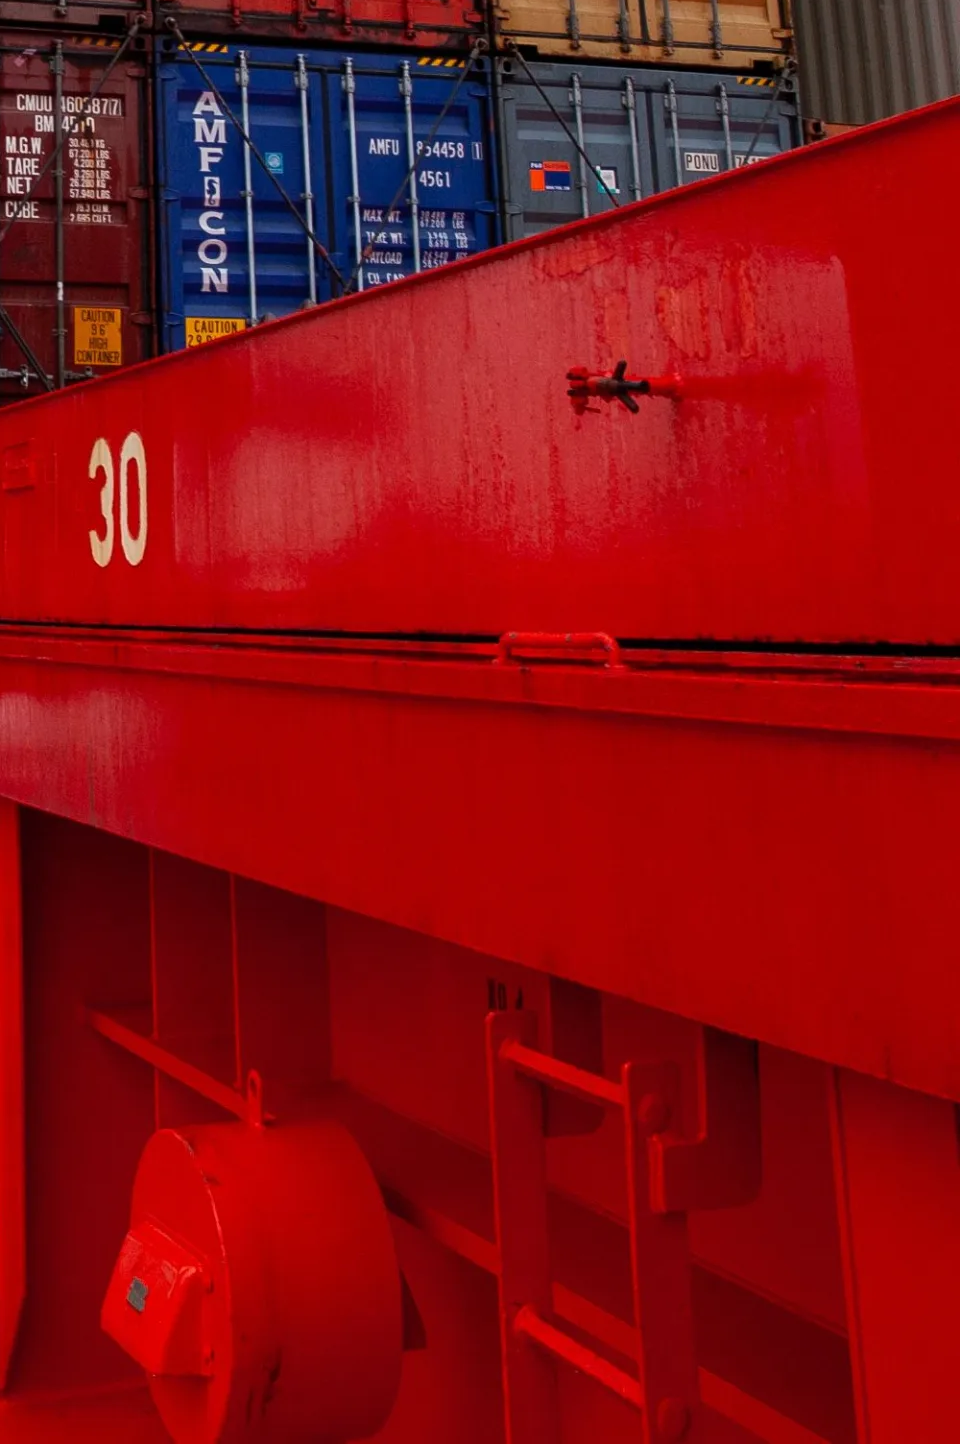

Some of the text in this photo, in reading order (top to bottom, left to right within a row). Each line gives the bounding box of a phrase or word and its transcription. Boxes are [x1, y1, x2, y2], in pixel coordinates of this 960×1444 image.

[16, 94, 53, 112] CMUU
[35, 115, 55, 133] BM
[368, 138, 400, 156] AMFU
[6, 157, 40, 177] TARE
[685, 154, 719, 172] PONU
[7, 177, 32, 195] NET
[420, 170, 451, 188] 45G1
[5, 201, 39, 219] CUBE
[453, 220, 466, 230] LBS
[81, 309, 115, 324] CAUTION
[194, 319, 238, 334] CAUTION
[89, 336, 109, 350] HIGH
[77, 351, 120, 364] CONTAINER
[87, 432, 148, 568] 30
